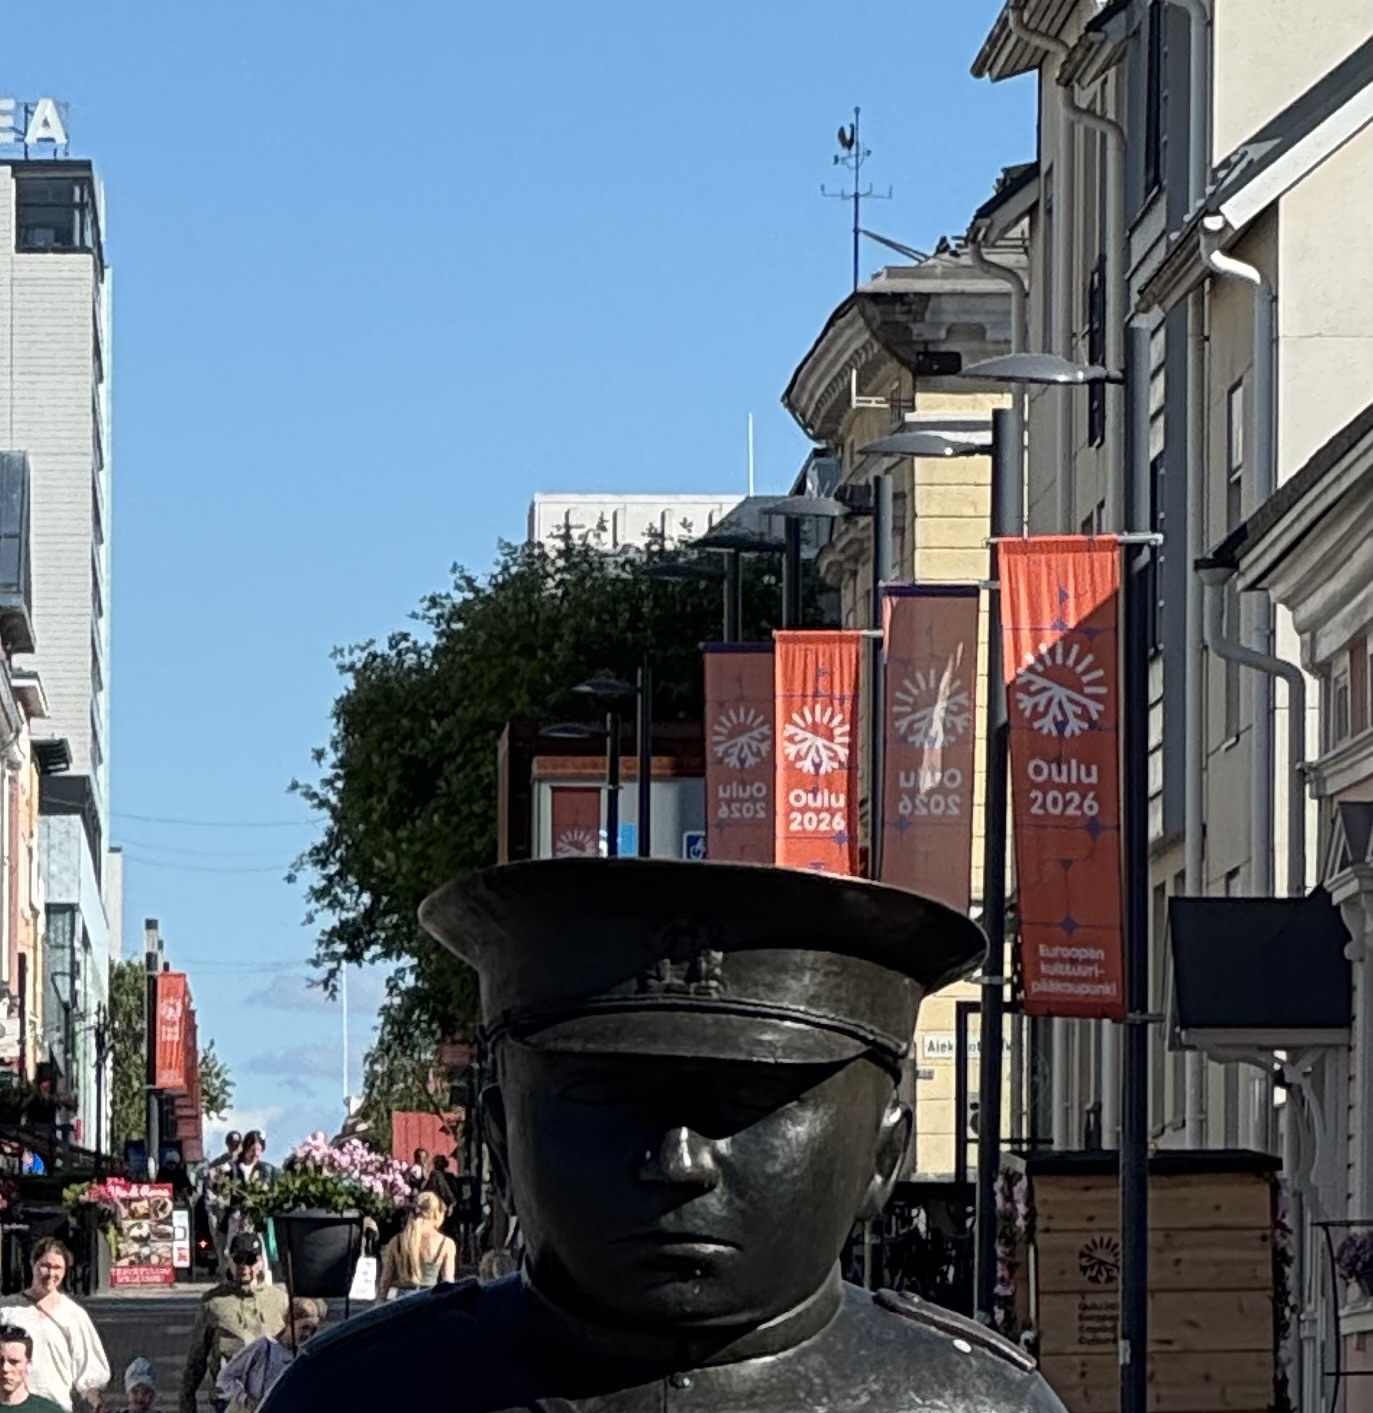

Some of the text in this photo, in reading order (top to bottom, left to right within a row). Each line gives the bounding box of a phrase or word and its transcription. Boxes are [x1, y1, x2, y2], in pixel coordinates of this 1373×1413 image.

[1027, 758, 1098, 785] Oulu
[788, 789, 846, 808] Oulu
[1029, 789, 1099, 816] 2026
[789, 811, 846, 831] 2026
[1038, 944, 1105, 960] Euroopan
